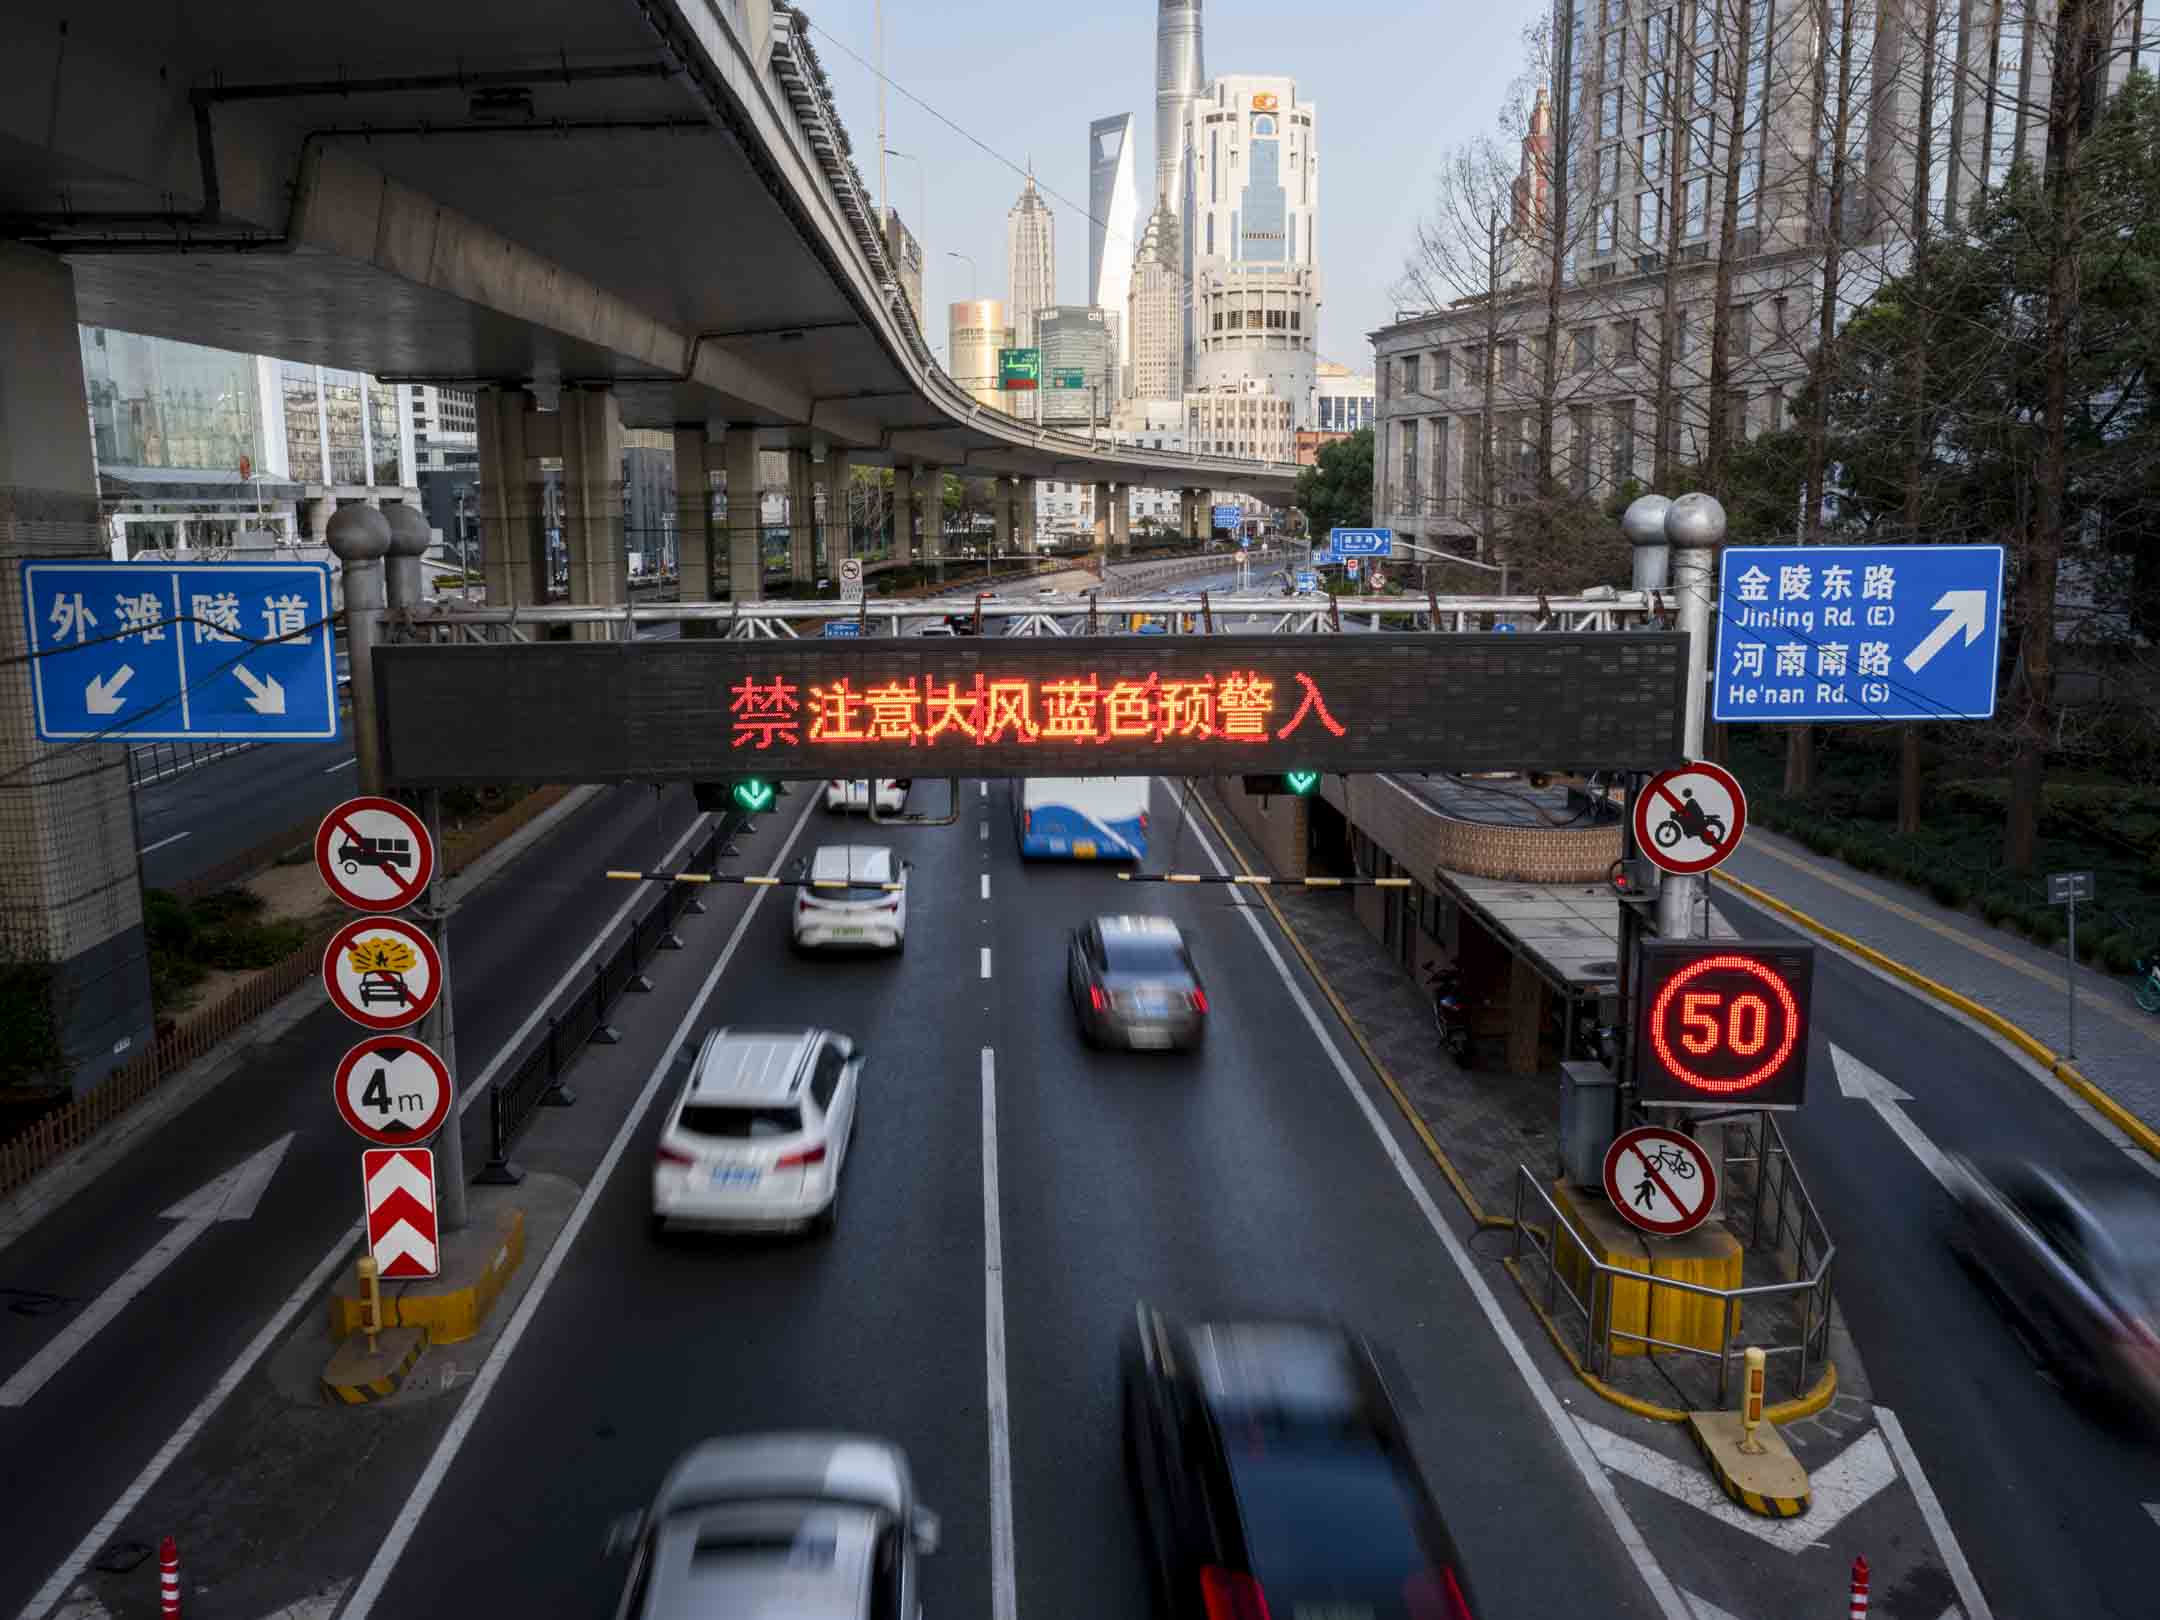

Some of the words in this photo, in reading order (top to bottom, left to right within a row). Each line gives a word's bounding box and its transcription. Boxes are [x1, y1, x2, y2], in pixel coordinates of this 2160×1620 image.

[1737, 564, 1897, 601] 金陵东路
[1735, 607, 1815, 632] Jinling
[1824, 606, 1855, 626] Rd.
[1866, 605, 1895, 625] (E)
[1731, 641, 1892, 677] 河南南路
[1728, 683, 1805, 704] He'nan
[1816, 683, 1848, 703] Rd.
[1861, 682, 1890, 703] (S)
[1682, 994, 1767, 1054] 50
